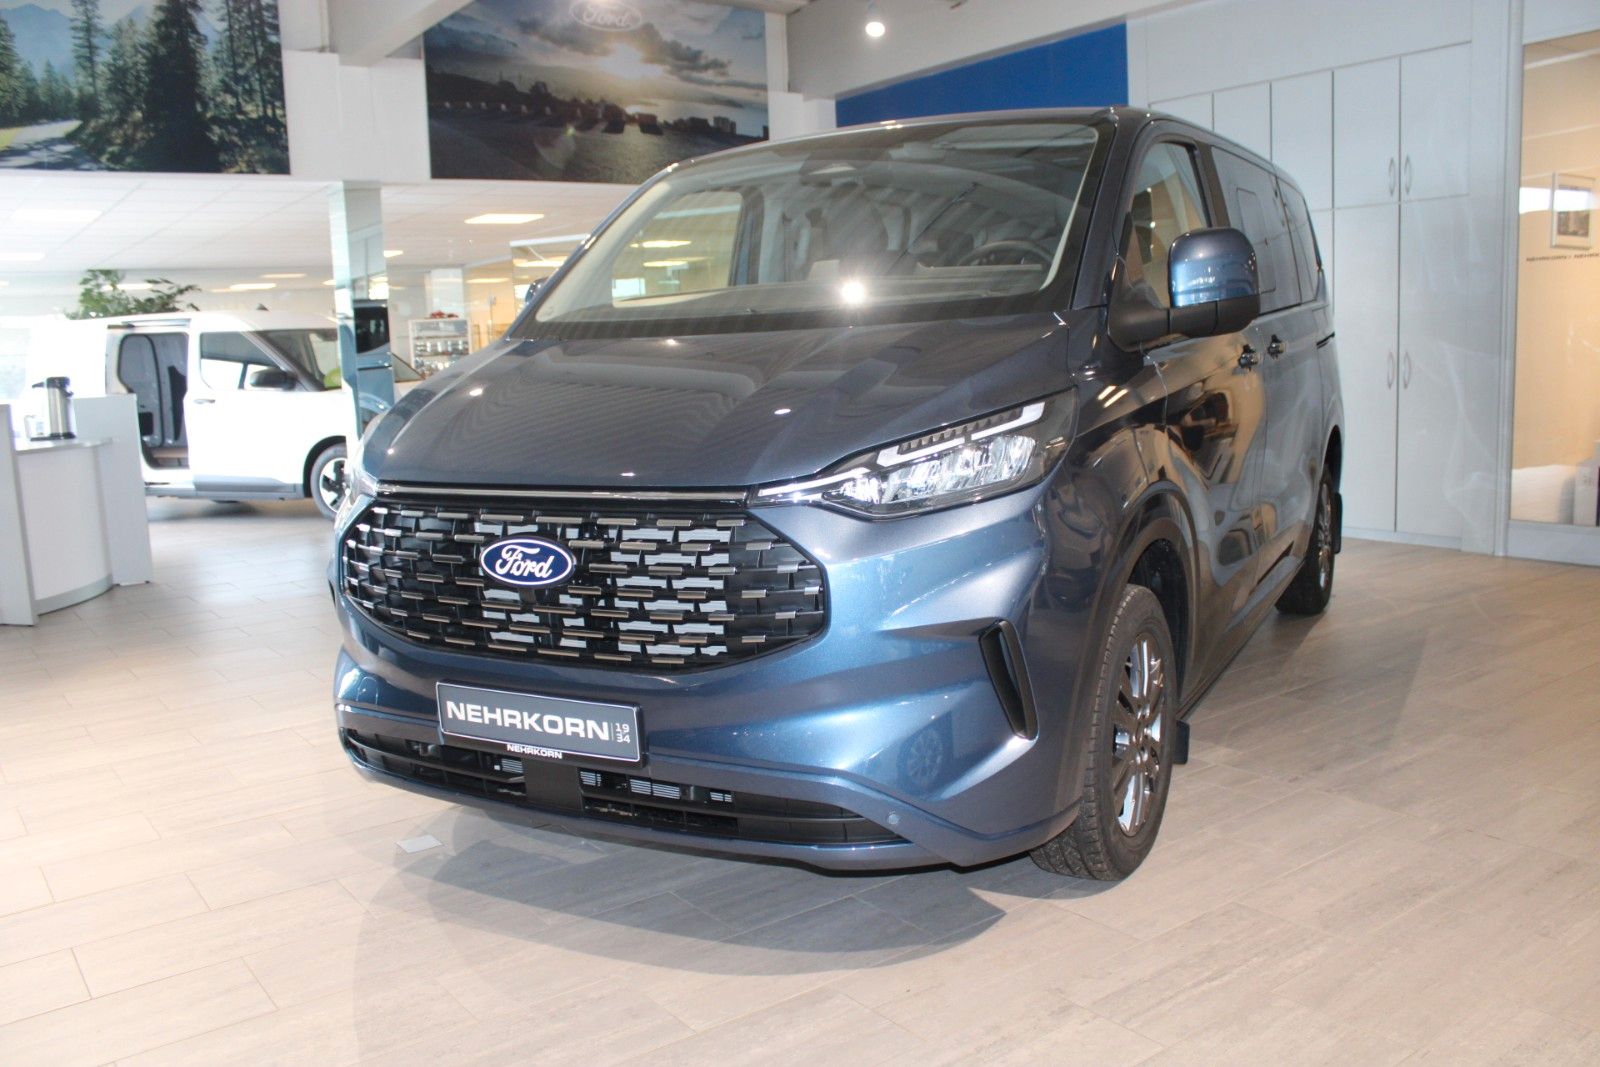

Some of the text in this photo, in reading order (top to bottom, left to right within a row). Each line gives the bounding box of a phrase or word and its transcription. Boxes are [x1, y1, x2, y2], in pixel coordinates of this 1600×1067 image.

[495, 544, 555, 578] Ford
[446, 700, 609, 741] NEHRKORN
[615, 722, 630, 733] 19
[616, 733, 631, 744] 34
[506, 744, 563, 759] NEHRKORN
